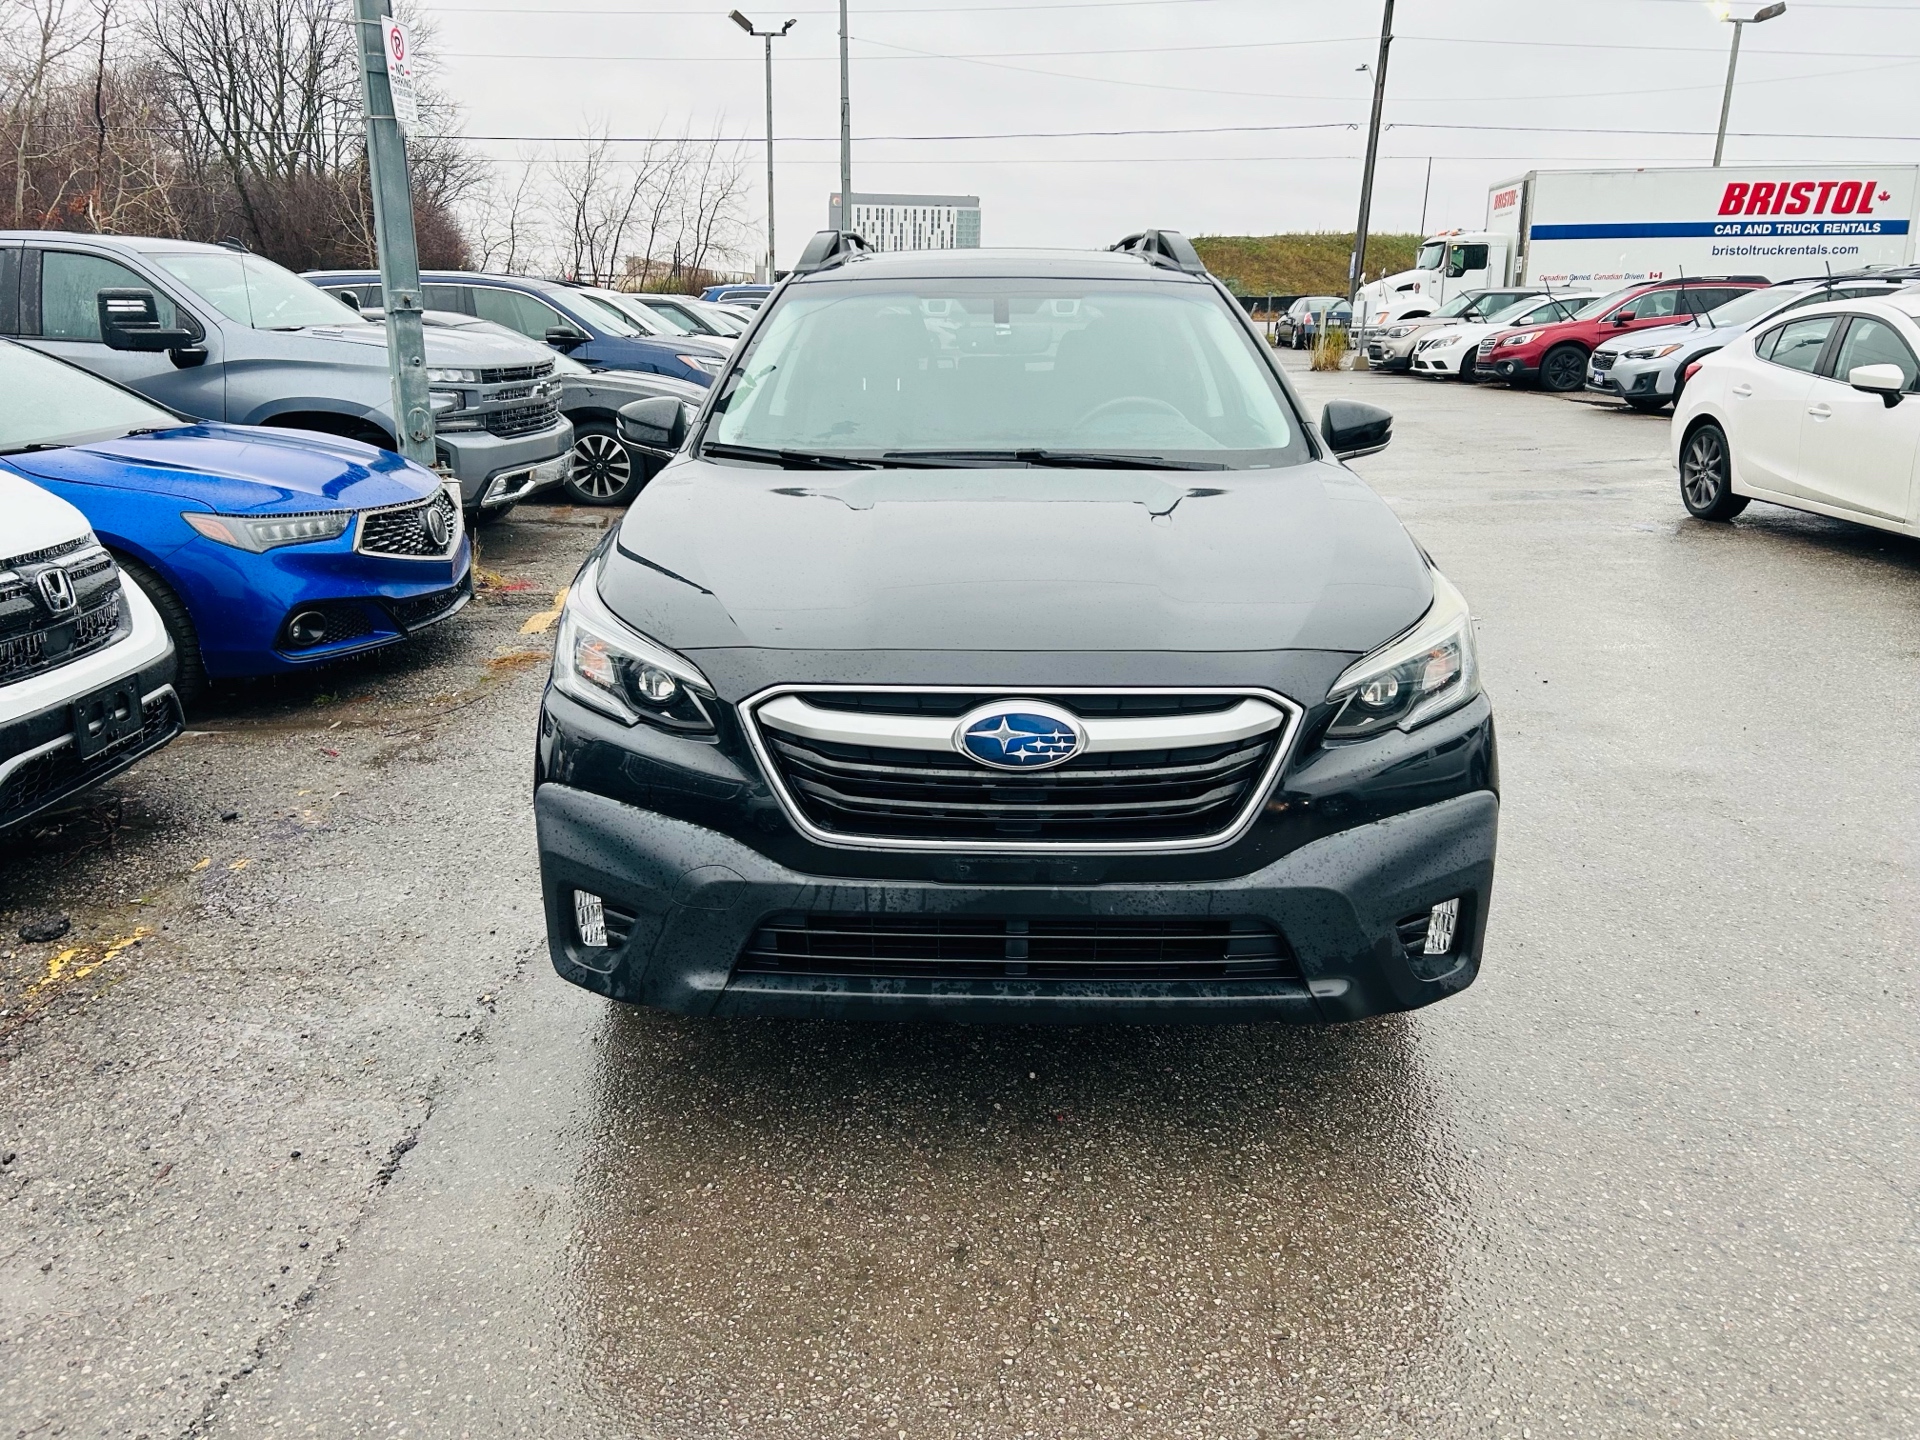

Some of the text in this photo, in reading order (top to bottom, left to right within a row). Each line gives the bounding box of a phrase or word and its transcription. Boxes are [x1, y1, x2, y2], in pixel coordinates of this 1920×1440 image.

[395, 62, 404, 76] NO
[1494, 189, 1516, 210] BRISTOL
[1717, 181, 1878, 216] BRISTOL
[1714, 222, 1881, 235] CAR AND TRUCK RENTALS
[1711, 244, 1859, 256] bristoltruckrentals.com
[1593, 273, 1624, 281] Canadian
